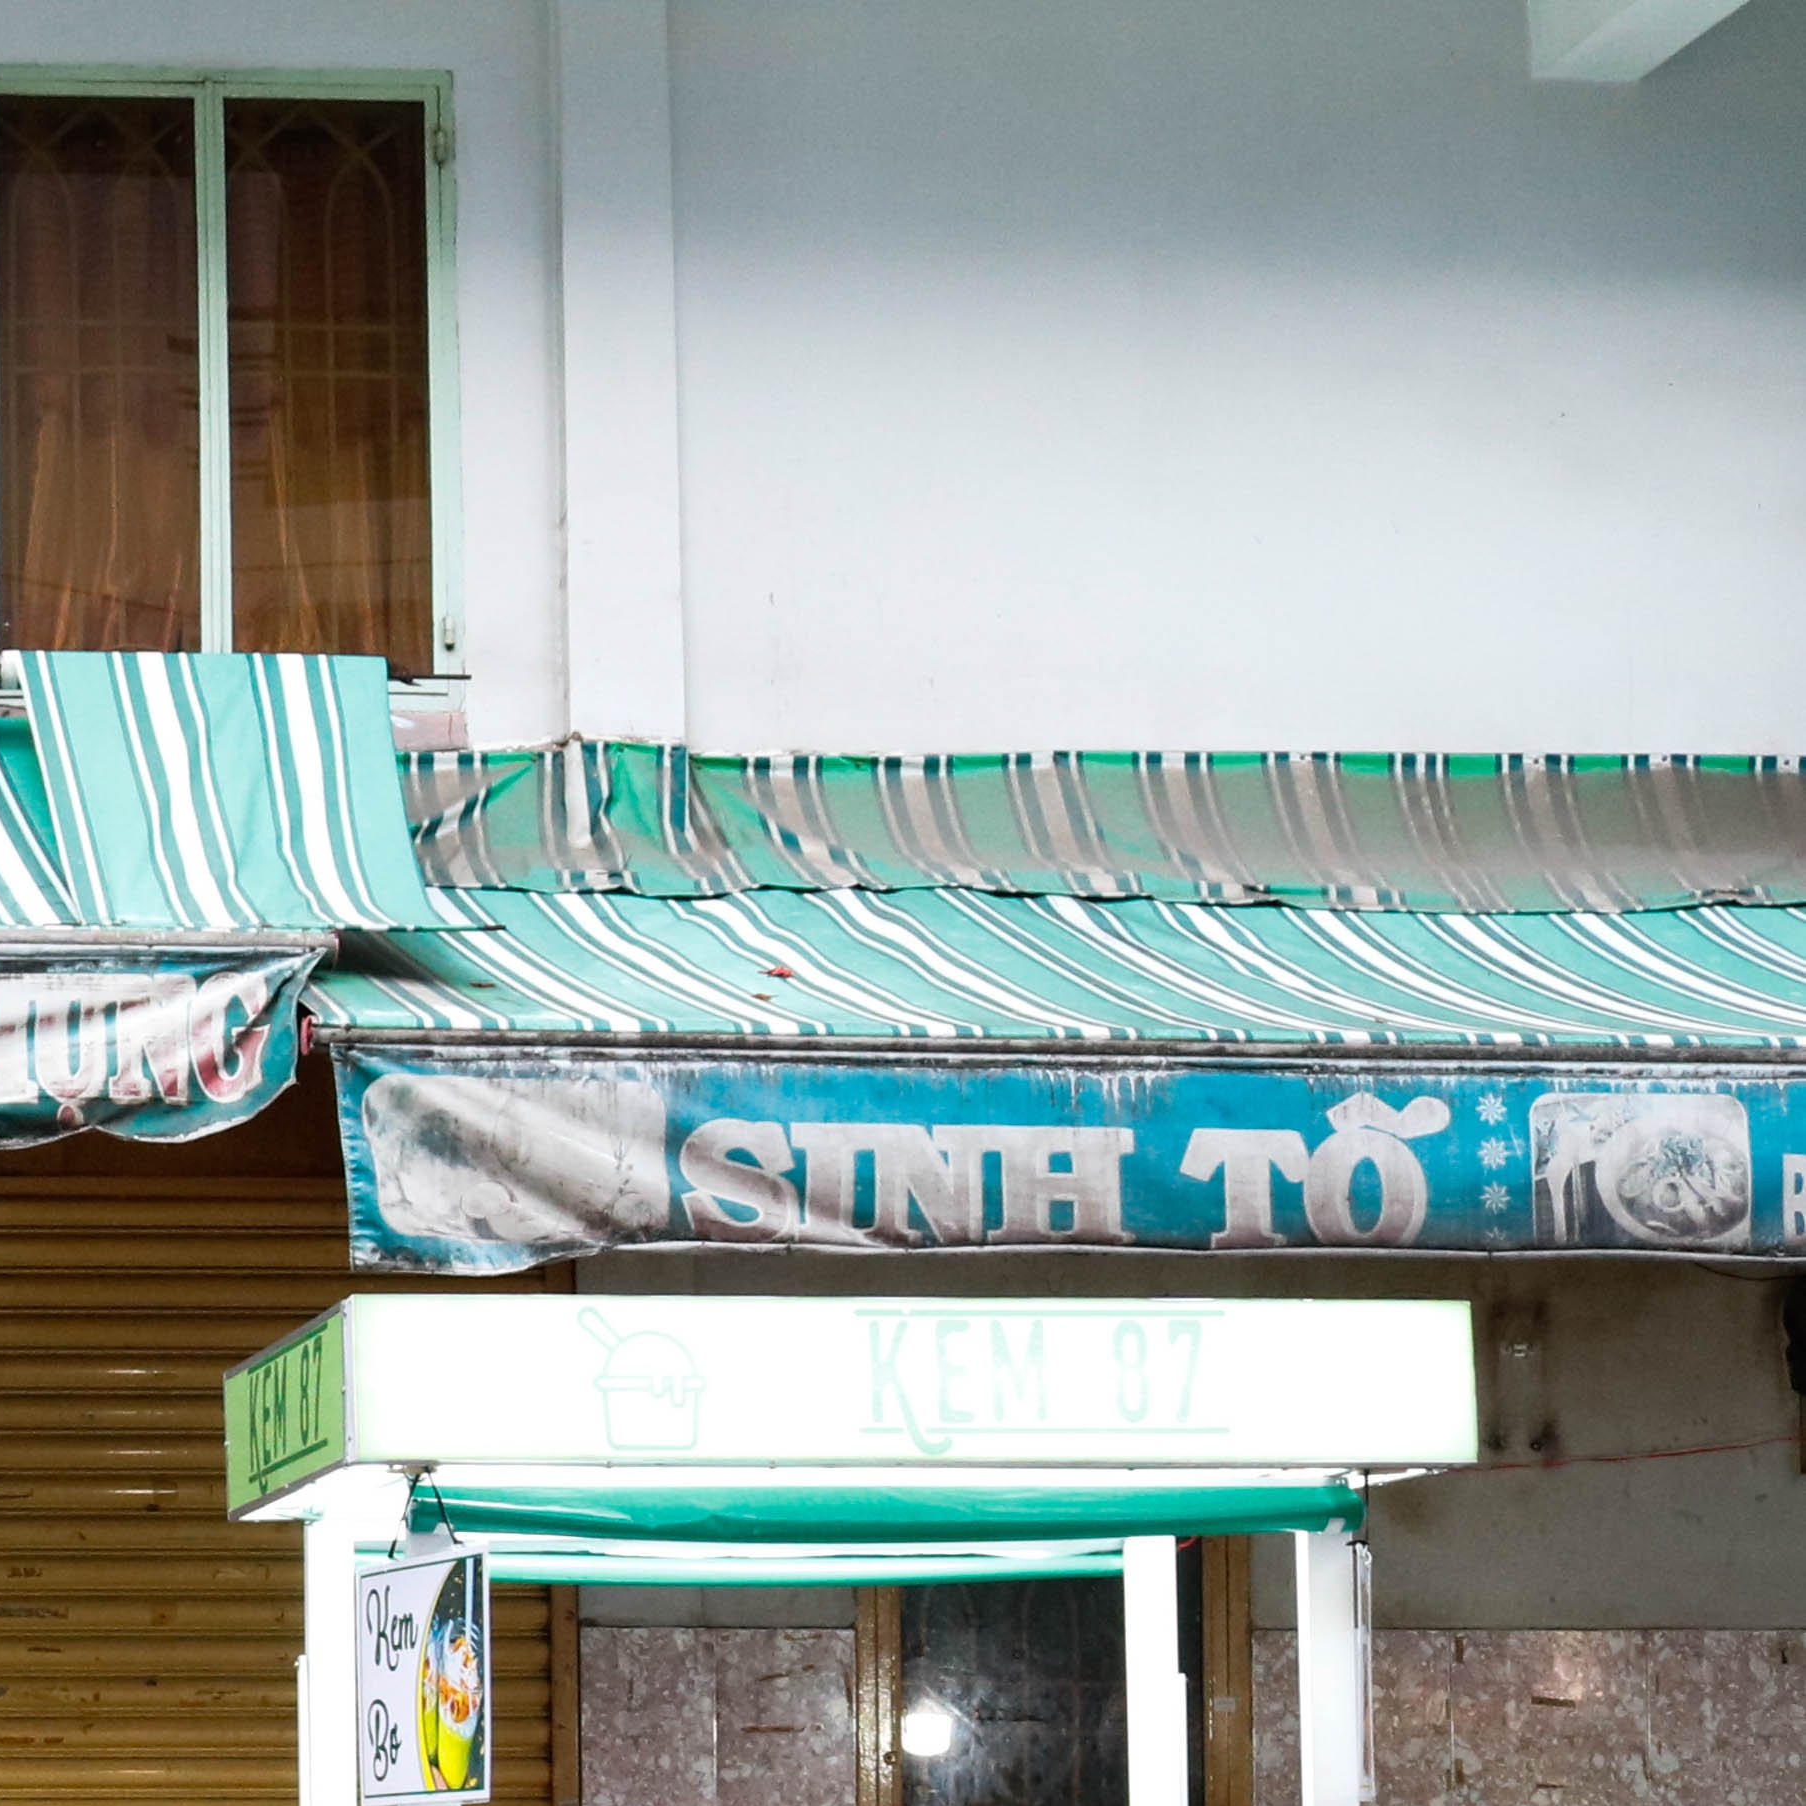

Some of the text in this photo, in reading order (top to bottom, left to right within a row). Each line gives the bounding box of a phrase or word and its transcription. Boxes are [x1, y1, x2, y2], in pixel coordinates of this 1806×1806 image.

[678, 1116, 1136, 1245] SINH
[249, 1335, 322, 1495] KEM 87
[869, 1319, 1203, 1455] KEM 87
[366, 1584, 419, 1671] Kem
